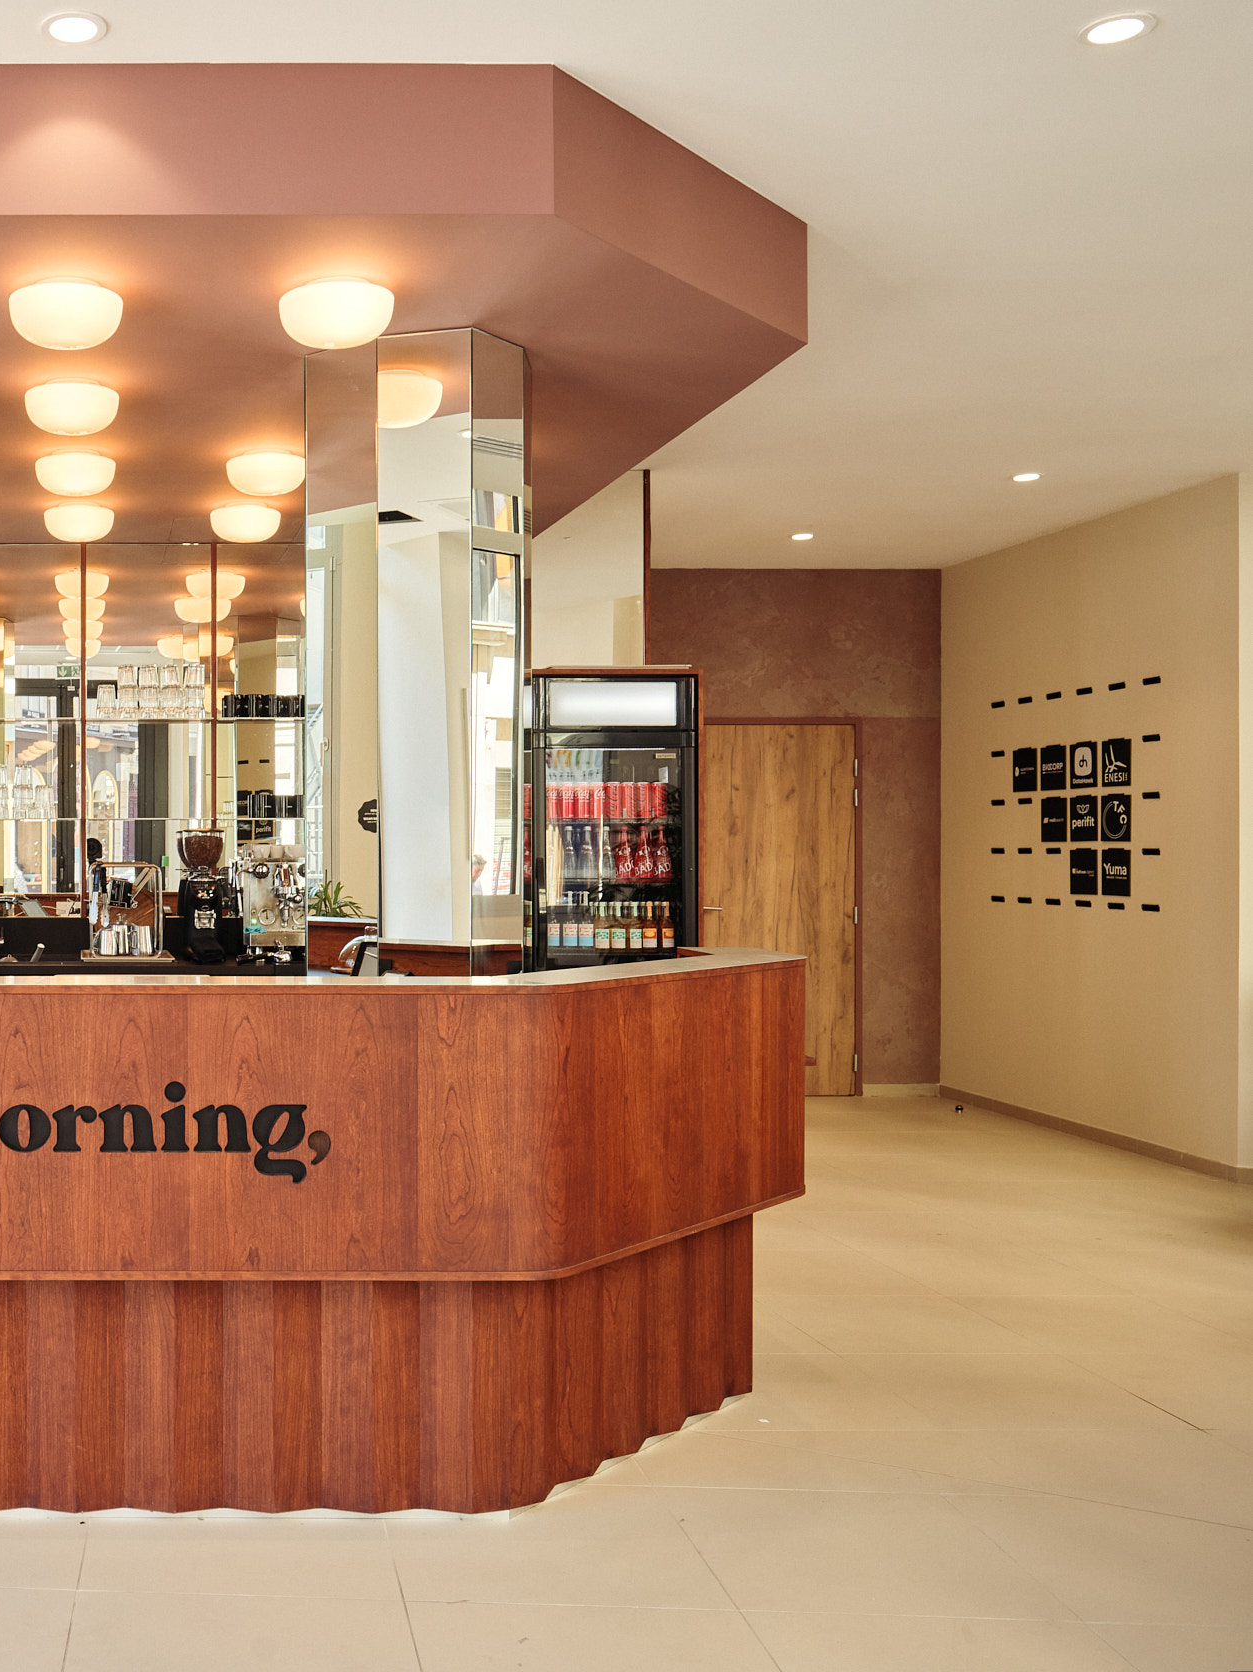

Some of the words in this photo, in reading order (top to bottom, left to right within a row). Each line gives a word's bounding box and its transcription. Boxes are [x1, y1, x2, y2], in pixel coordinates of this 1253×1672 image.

[1104, 772, 1125, 783] ENESI
[1072, 816, 1095, 830] perifit
[1103, 862, 1127, 876] Yuma
